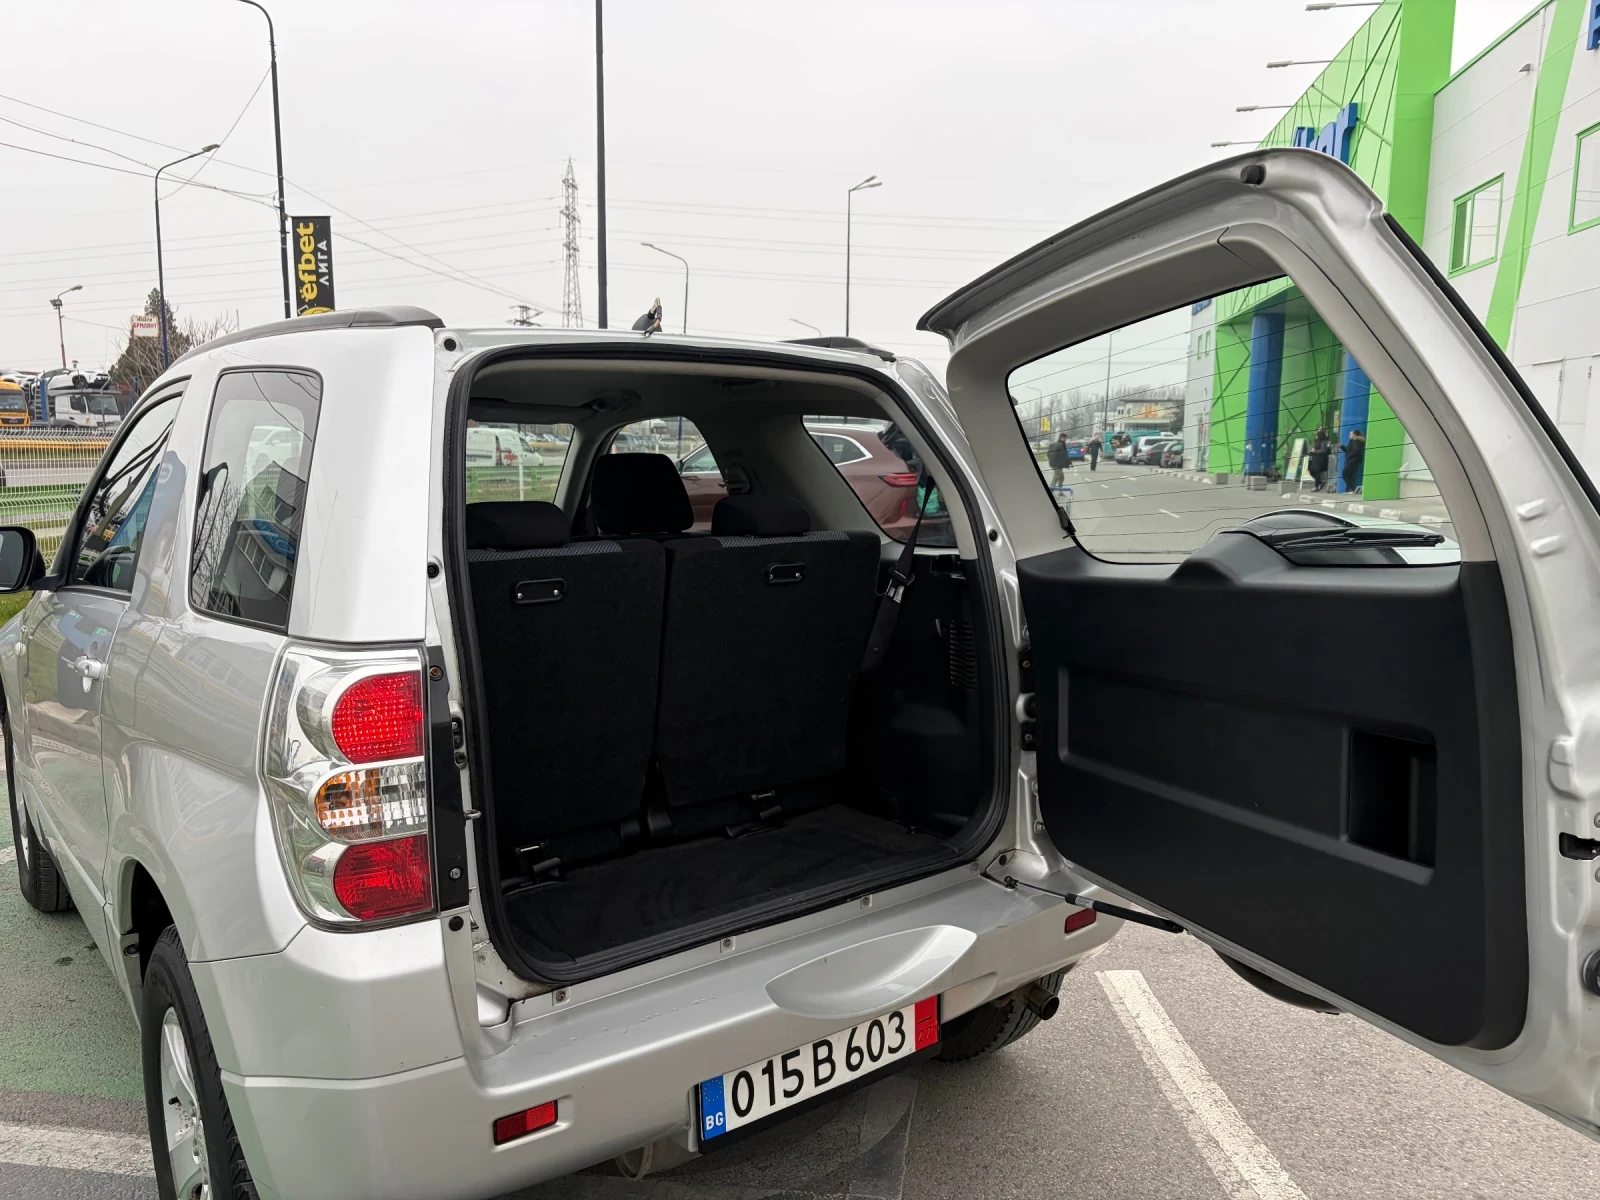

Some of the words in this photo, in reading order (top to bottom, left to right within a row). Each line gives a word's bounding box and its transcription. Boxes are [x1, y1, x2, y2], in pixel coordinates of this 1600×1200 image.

[296, 222, 318, 301] efbet
[317, 239, 330, 286] ЛИГА
[918, 1026, 933, 1043] 27
[705, 1111, 724, 1131] BG
